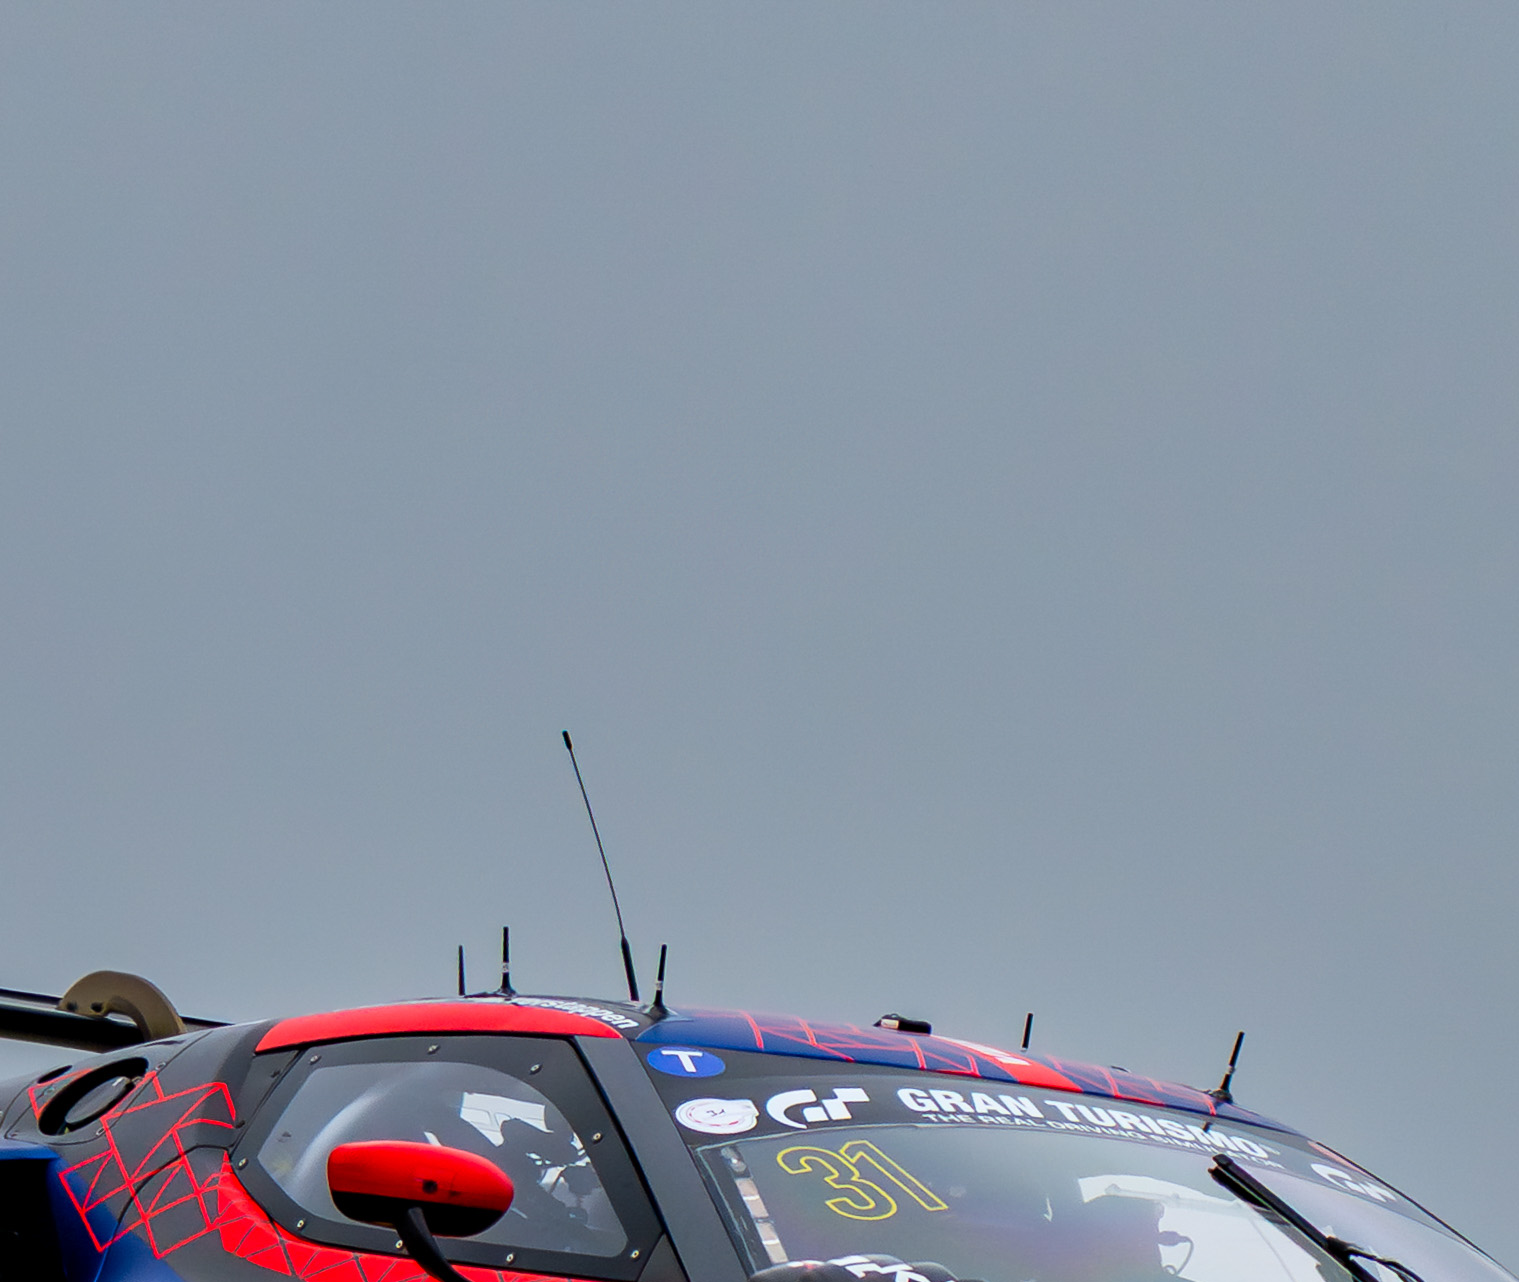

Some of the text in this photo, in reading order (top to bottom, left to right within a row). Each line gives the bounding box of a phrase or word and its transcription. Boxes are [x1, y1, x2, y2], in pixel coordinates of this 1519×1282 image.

[661, 1049, 703, 1073] T
[897, 1088, 1268, 1159] GRAN TURISMO
[921, 1113, 977, 1124] THE
[977, 1115, 1047, 1128] REAL
[776, 1140, 948, 1220] 31
